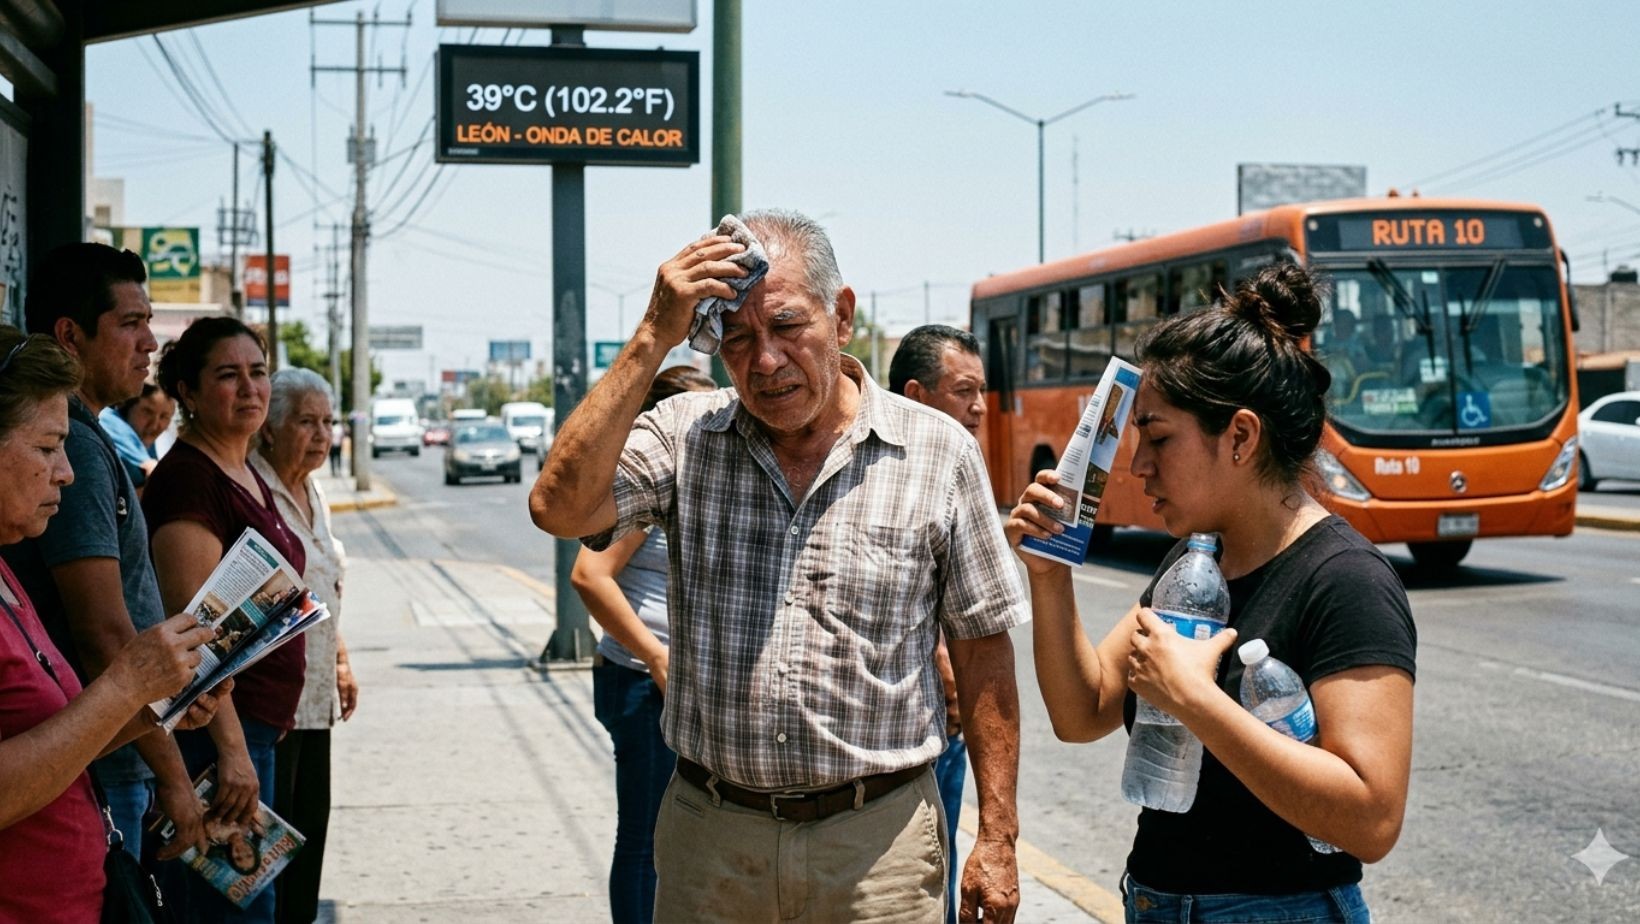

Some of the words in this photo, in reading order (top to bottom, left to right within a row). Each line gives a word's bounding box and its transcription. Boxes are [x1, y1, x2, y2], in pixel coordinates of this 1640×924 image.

[457, 122, 510, 143] LEÓN
[526, 126, 582, 145] ONDA
[586, 128, 612, 145] DE
[616, 128, 683, 147] CALOR
[1372, 219, 1445, 246] RUTA
[1455, 219, 1485, 245] 10
[1375, 457, 1402, 474] Ruta
[1406, 456, 1419, 474] 10
